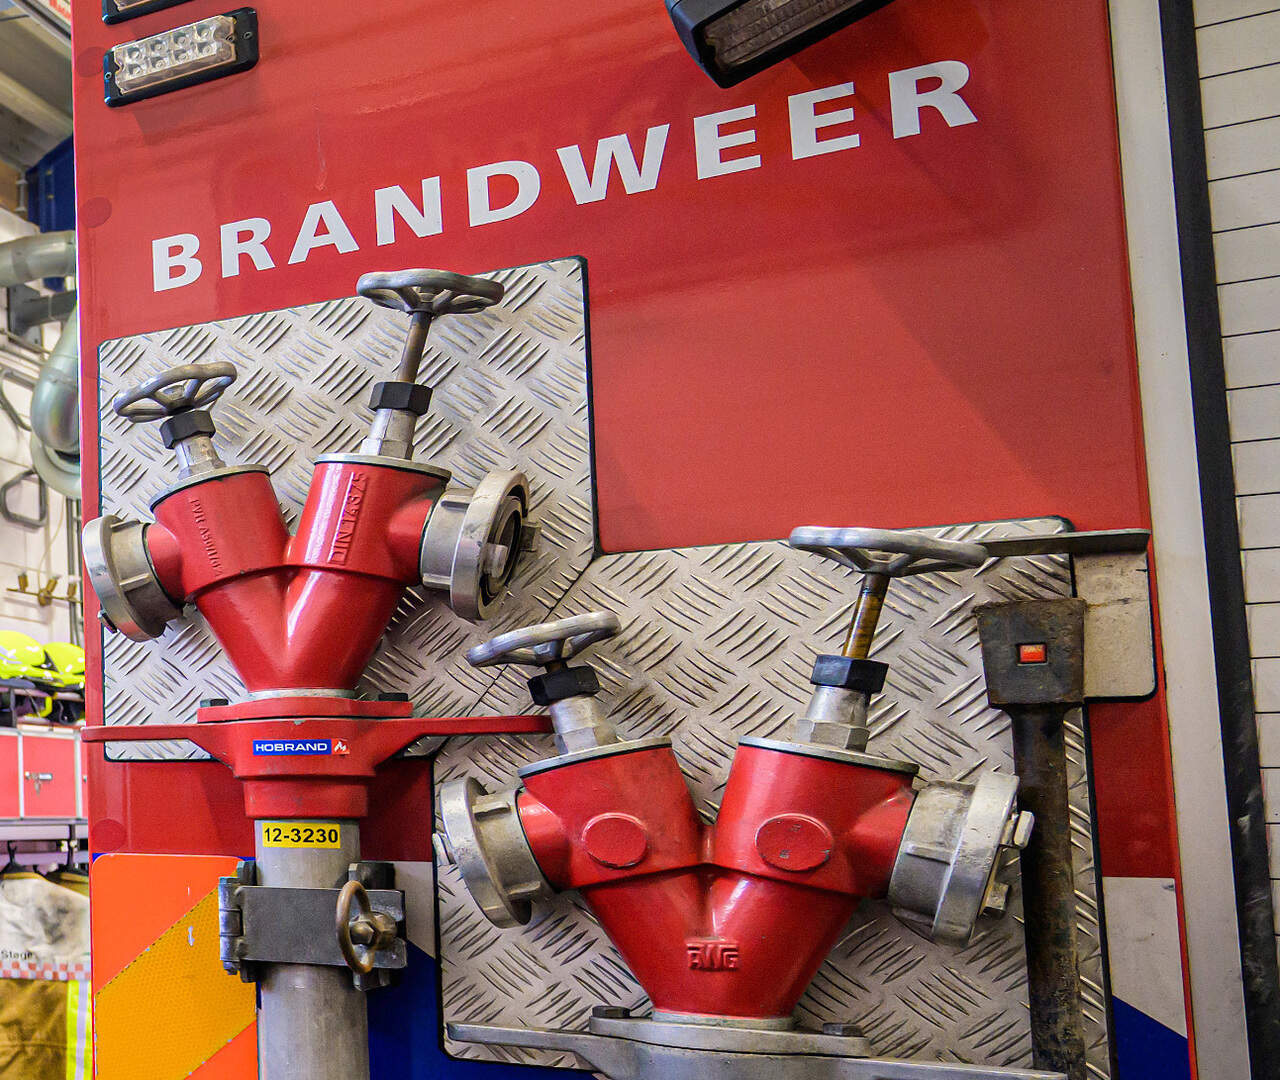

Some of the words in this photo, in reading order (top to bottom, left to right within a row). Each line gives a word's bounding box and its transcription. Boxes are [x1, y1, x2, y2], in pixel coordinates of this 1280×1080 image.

[151, 59, 978, 293] BRANDWEER
[255, 743, 328, 752] HOBRAND
[264, 827, 339, 844] 12-3230
[1, 948, 33, 960] Stage
